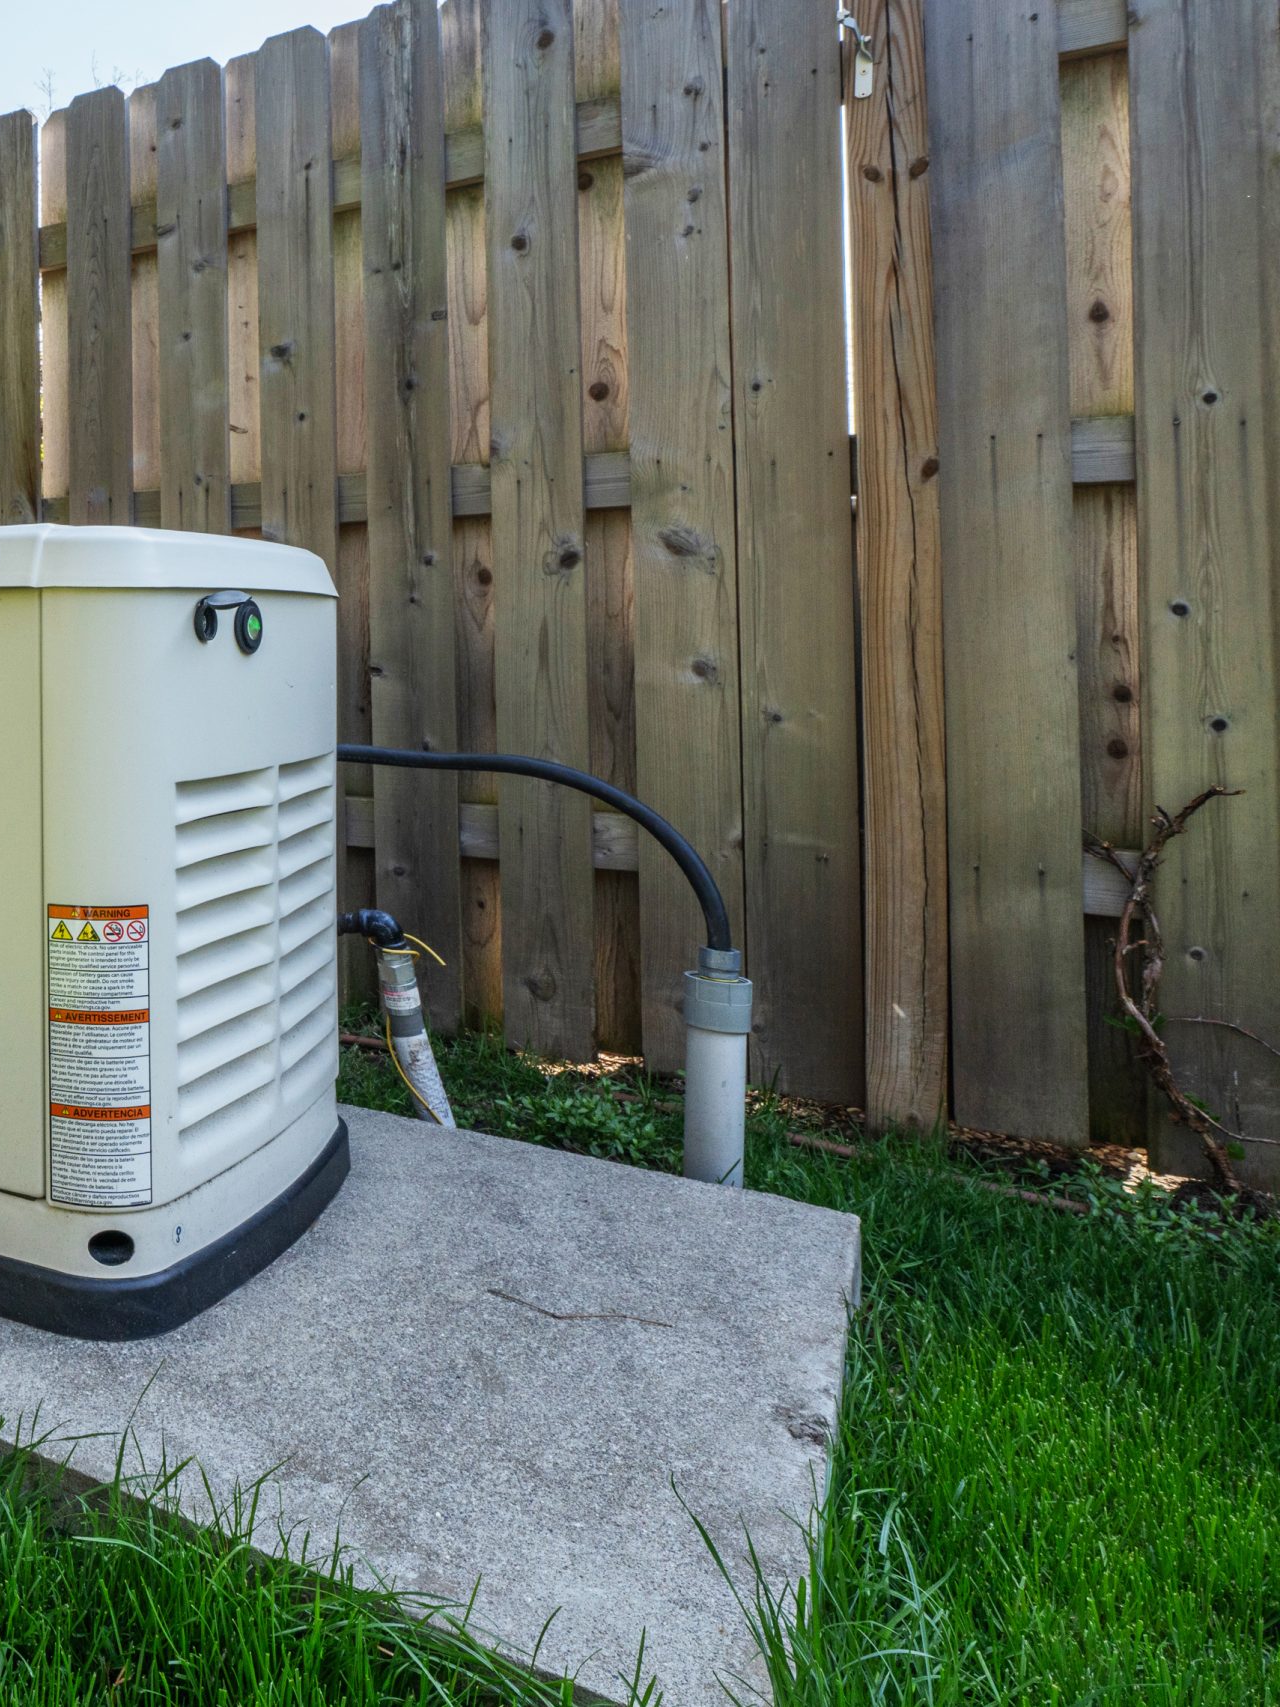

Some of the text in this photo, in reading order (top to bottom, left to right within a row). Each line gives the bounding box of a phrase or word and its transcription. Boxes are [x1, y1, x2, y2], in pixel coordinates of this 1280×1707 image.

[83, 909, 131, 918] WARNING
[65, 1012, 146, 1022] AVERTISSEMENT
[73, 1109, 143, 1118] ADVERTENCIA
